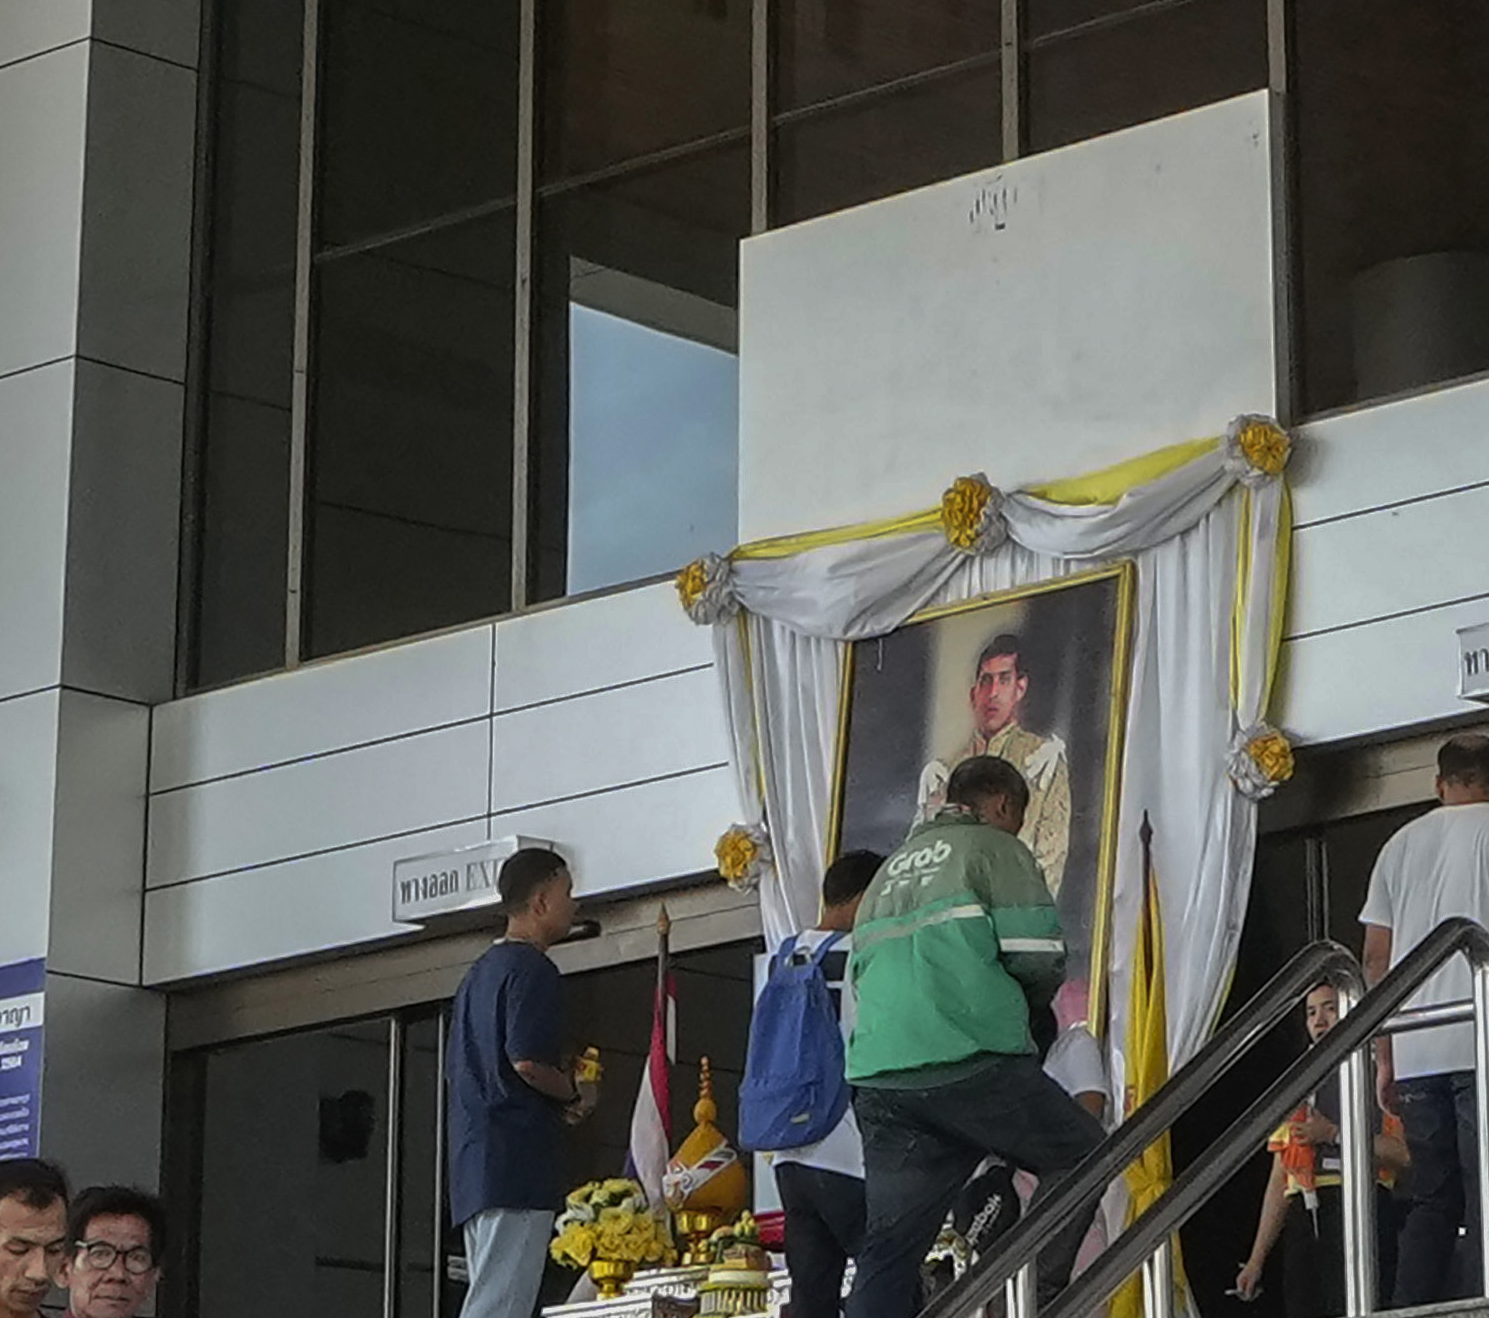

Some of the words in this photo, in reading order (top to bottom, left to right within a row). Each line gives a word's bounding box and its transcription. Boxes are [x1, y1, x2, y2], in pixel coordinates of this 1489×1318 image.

[888, 840, 952, 877] Grab
[400, 869, 459, 904] ทางออก
[466, 859, 499, 892] EXI
